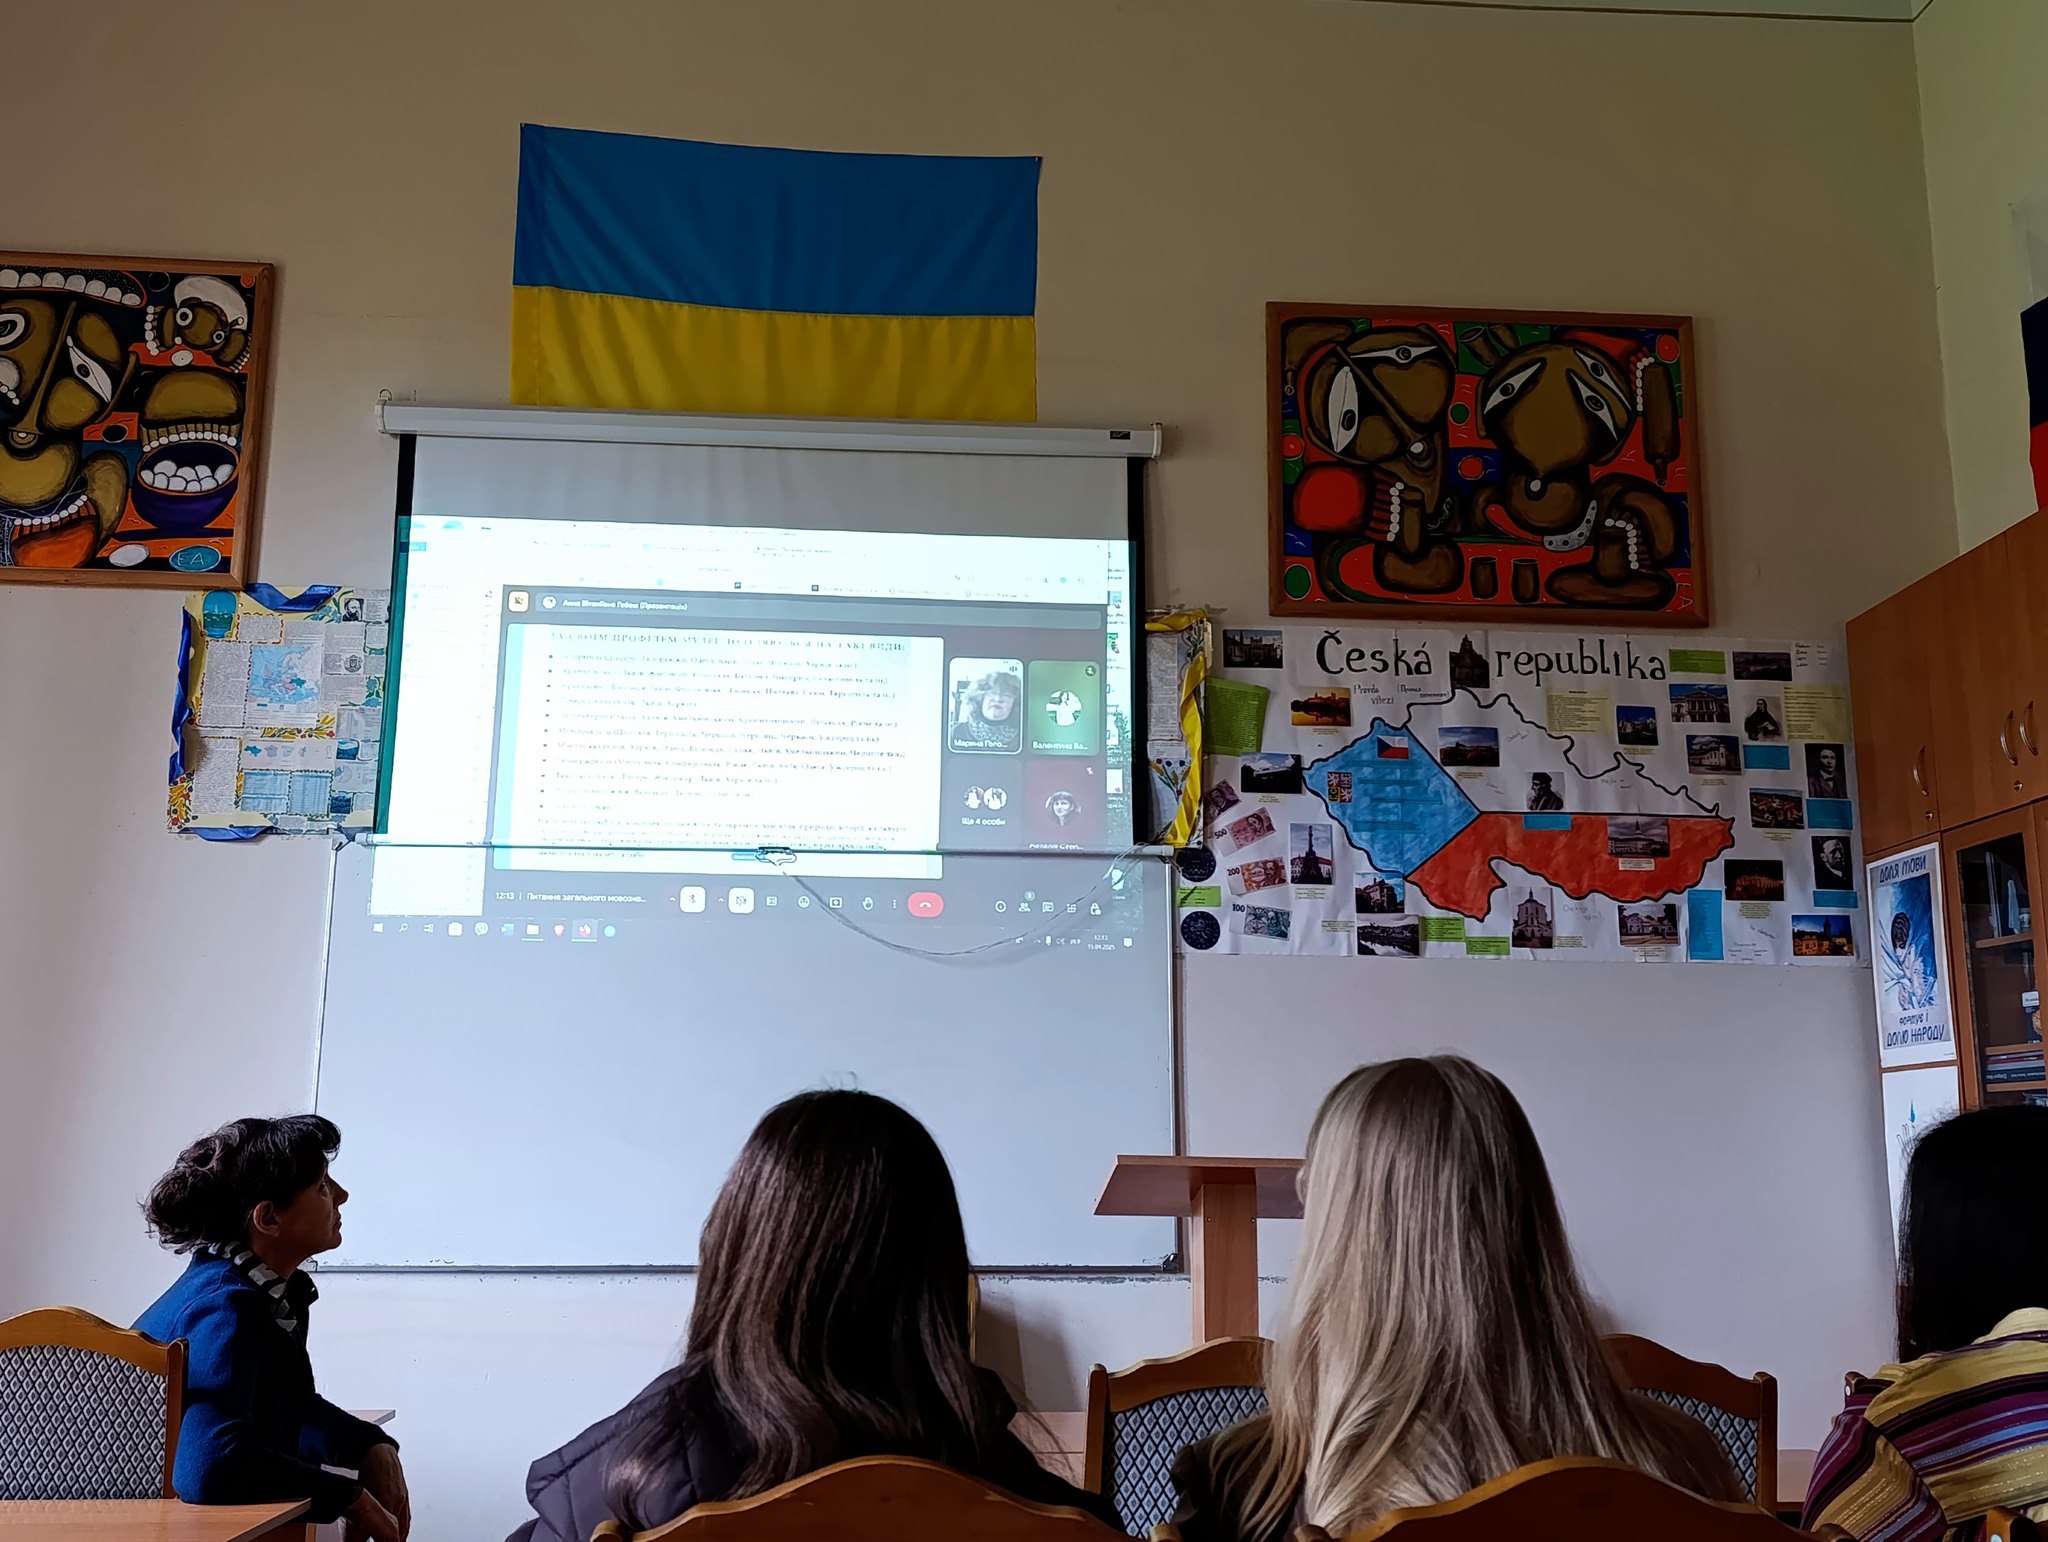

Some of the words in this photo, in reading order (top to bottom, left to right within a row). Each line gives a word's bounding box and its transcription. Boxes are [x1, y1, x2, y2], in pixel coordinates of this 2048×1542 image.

[1316, 629, 1433, 677] Česká
[1495, 638, 1667, 687] republika
[1032, 740, 1073, 750] Валентина
[961, 816, 975, 827] Ще
[976, 817, 981, 826] 4
[982, 817, 1006, 826] особи
[1214, 828, 1228, 840] 500
[1227, 867, 1241, 876] 200
[1880, 863, 1900, 883] ДОЛЯ
[1902, 854, 1927, 876] МОВИ
[495, 891, 515, 900] 12:13
[527, 892, 561, 901] Питання
[562, 893, 607, 903] загального
[1232, 903, 1246, 913] 100
[1887, 1029, 1909, 1047] ДОЛЮ
[1911, 1024, 1945, 1042] НАРОДУ
